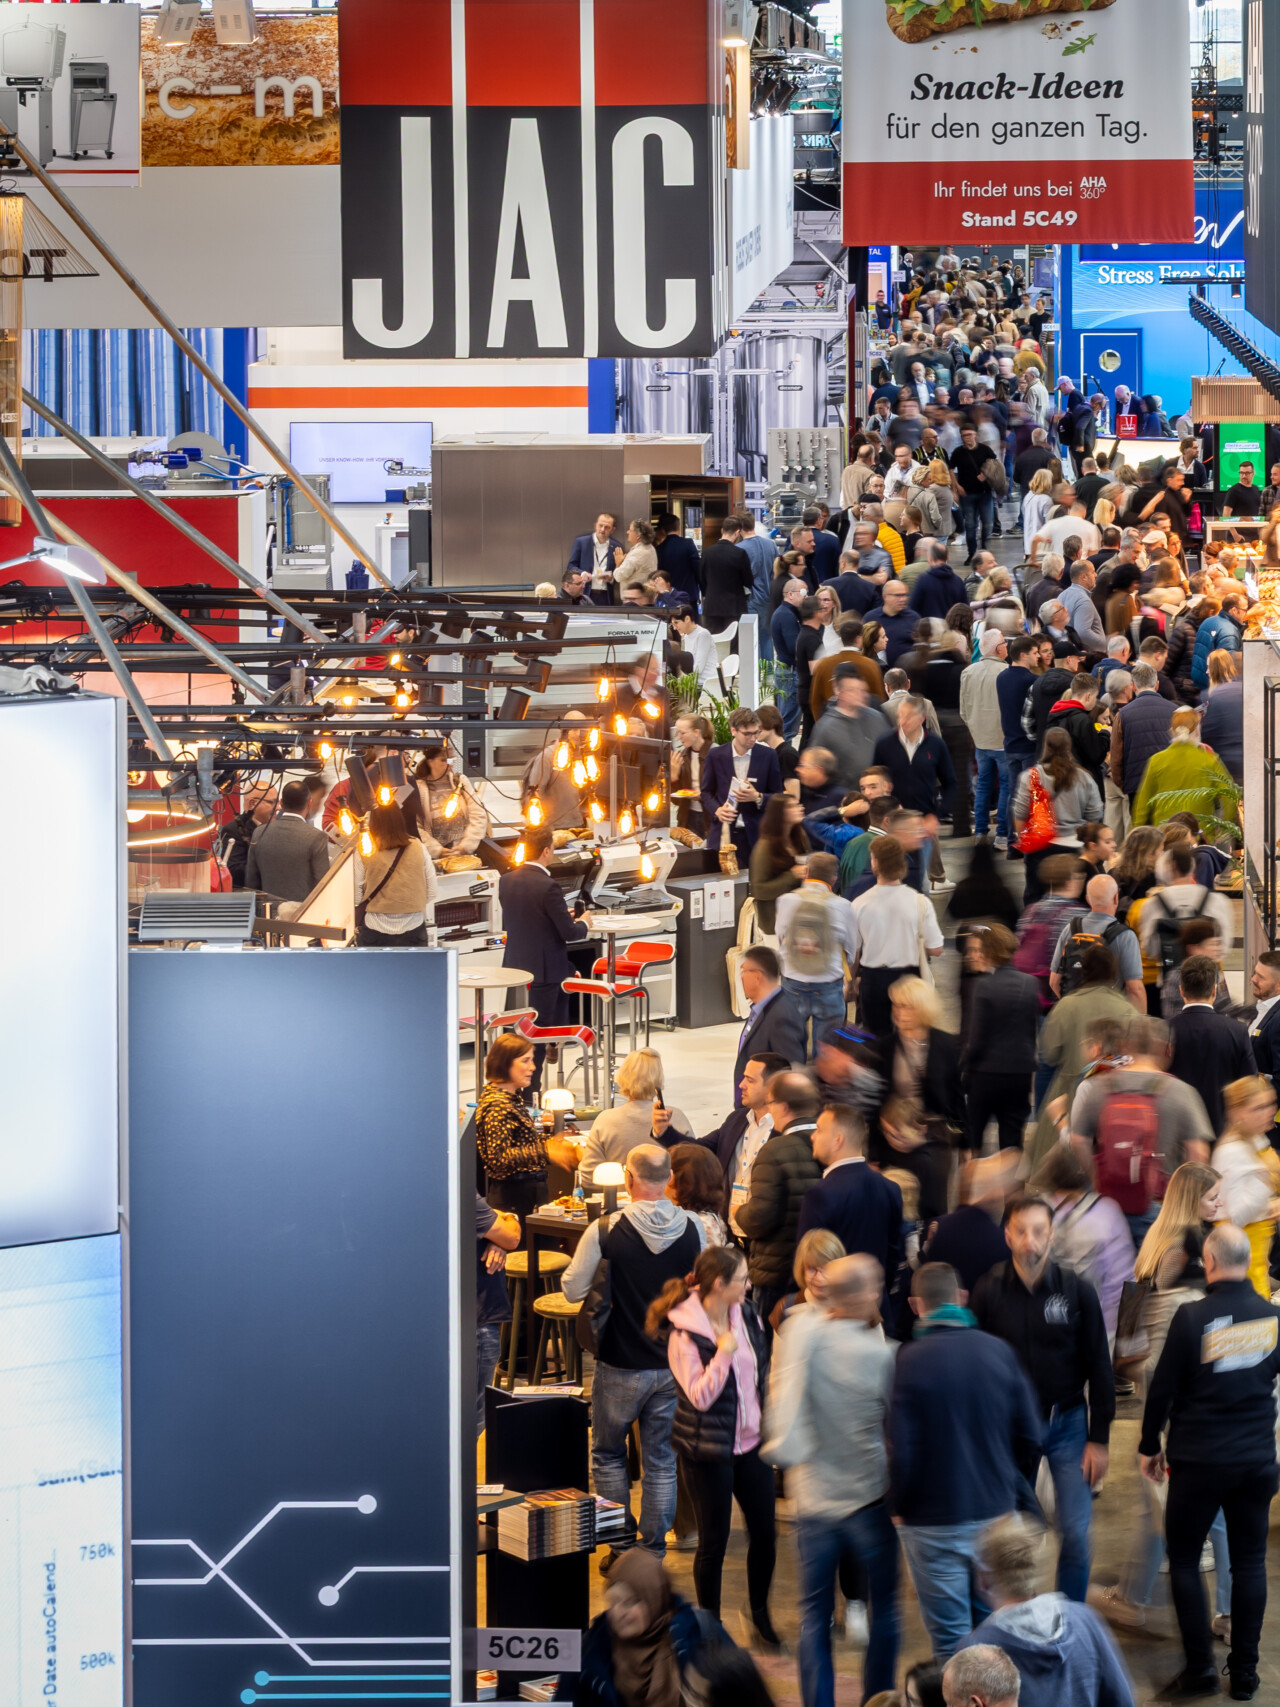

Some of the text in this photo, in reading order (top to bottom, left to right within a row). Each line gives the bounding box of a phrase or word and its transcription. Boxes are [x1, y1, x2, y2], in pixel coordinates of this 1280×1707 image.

[910, 72, 1124, 101] Snack-Ideen
[886, 112, 1148, 145] für den ganzen Tag.
[934, 179, 1073, 198] Ihr findet uns bei
[1079, 176, 1107, 188] AHA
[961, 209, 1079, 227] Stand 5C49
[352, 116, 697, 349] JAC
[1098, 265, 1154, 284] Stress
[1158, 266, 1202, 284] Free
[608, 629, 640, 637] FORNATA
[79, 1543, 116, 1561] 750k
[488, 1635, 560, 1660] 5C26
[80, 1651, 116, 1671] 500k
